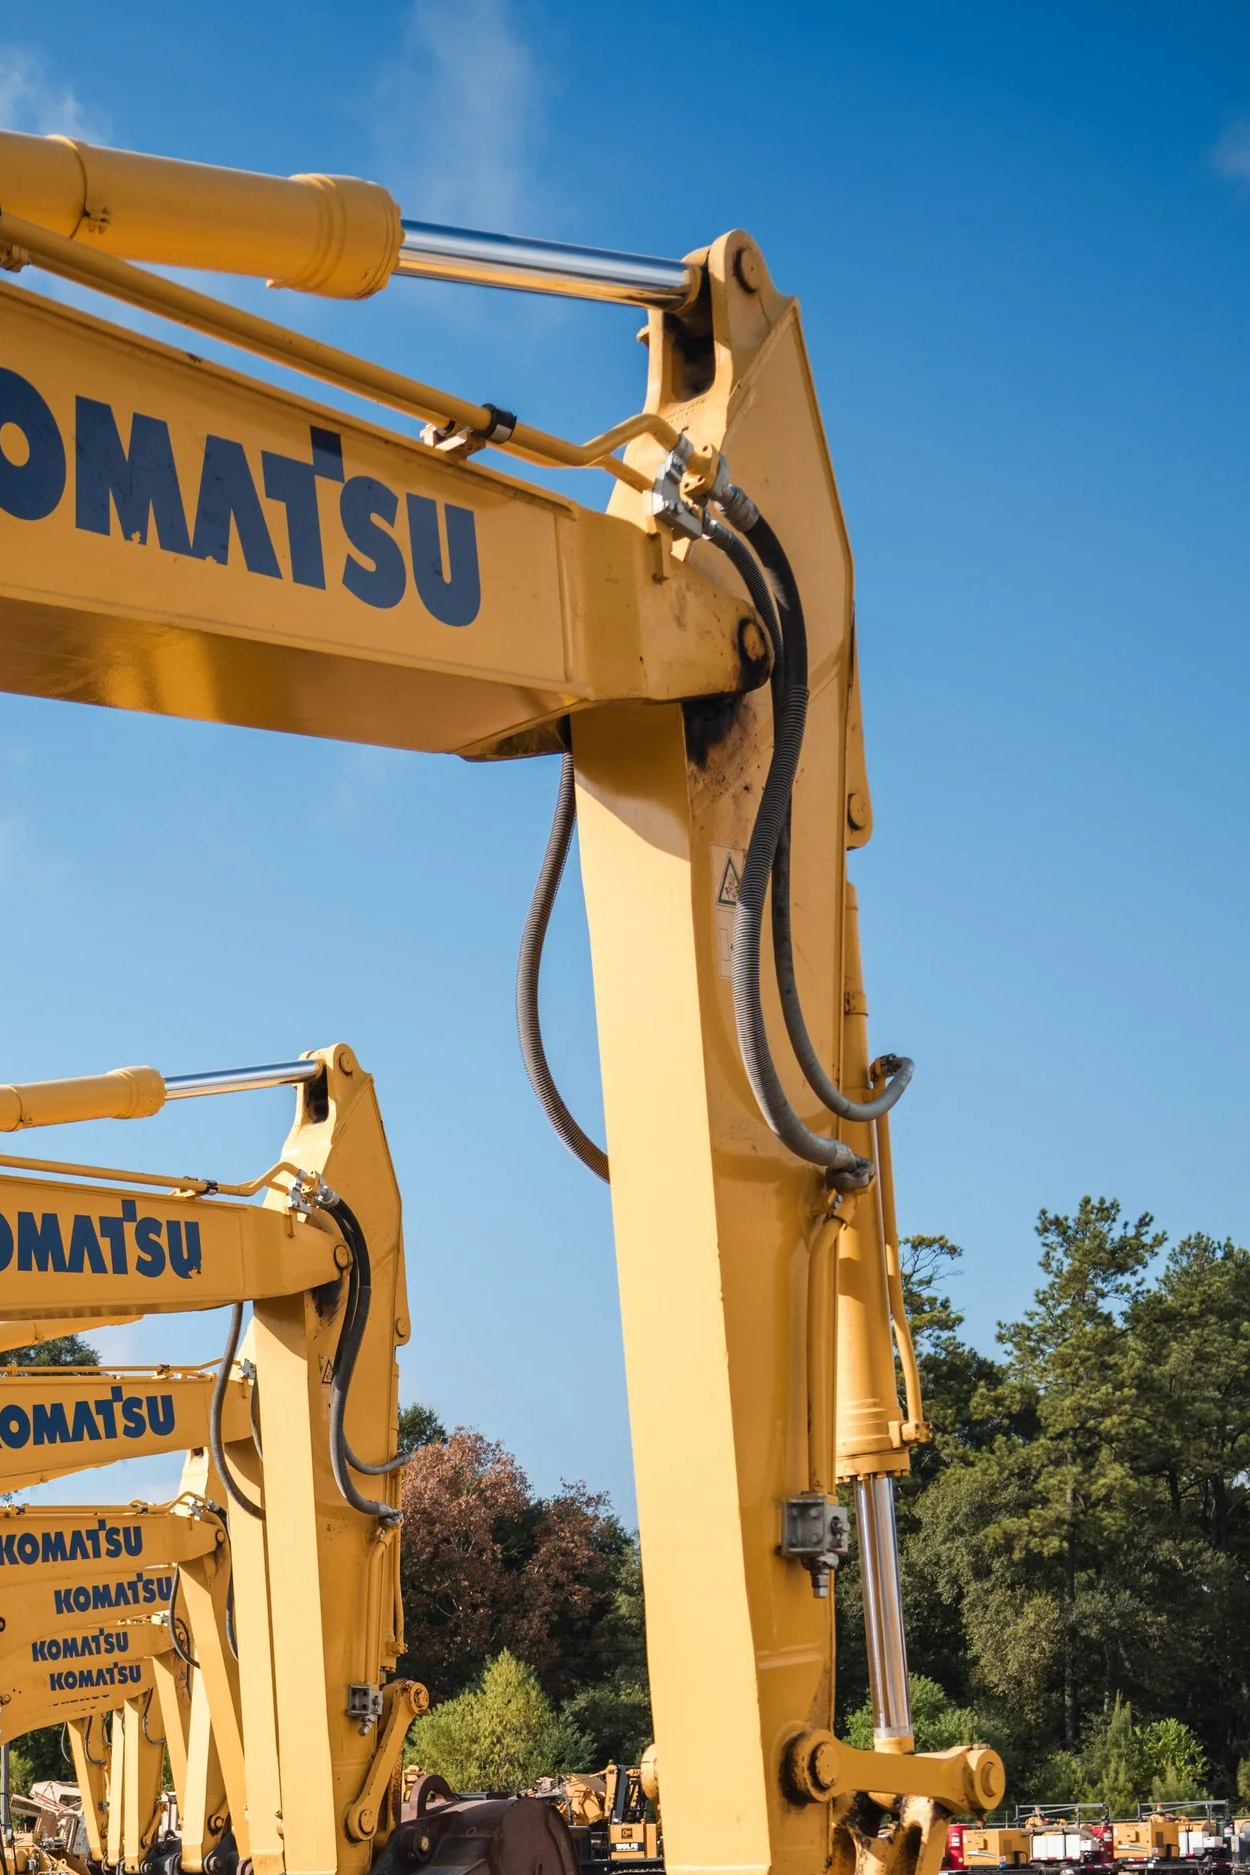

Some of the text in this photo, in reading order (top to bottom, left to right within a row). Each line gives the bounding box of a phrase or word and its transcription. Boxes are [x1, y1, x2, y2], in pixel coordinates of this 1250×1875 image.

[54, 1572, 172, 1614] KOMATSU
[31, 1628, 129, 1662] KOMATSU
[49, 1662, 141, 1691] KOMATSU
